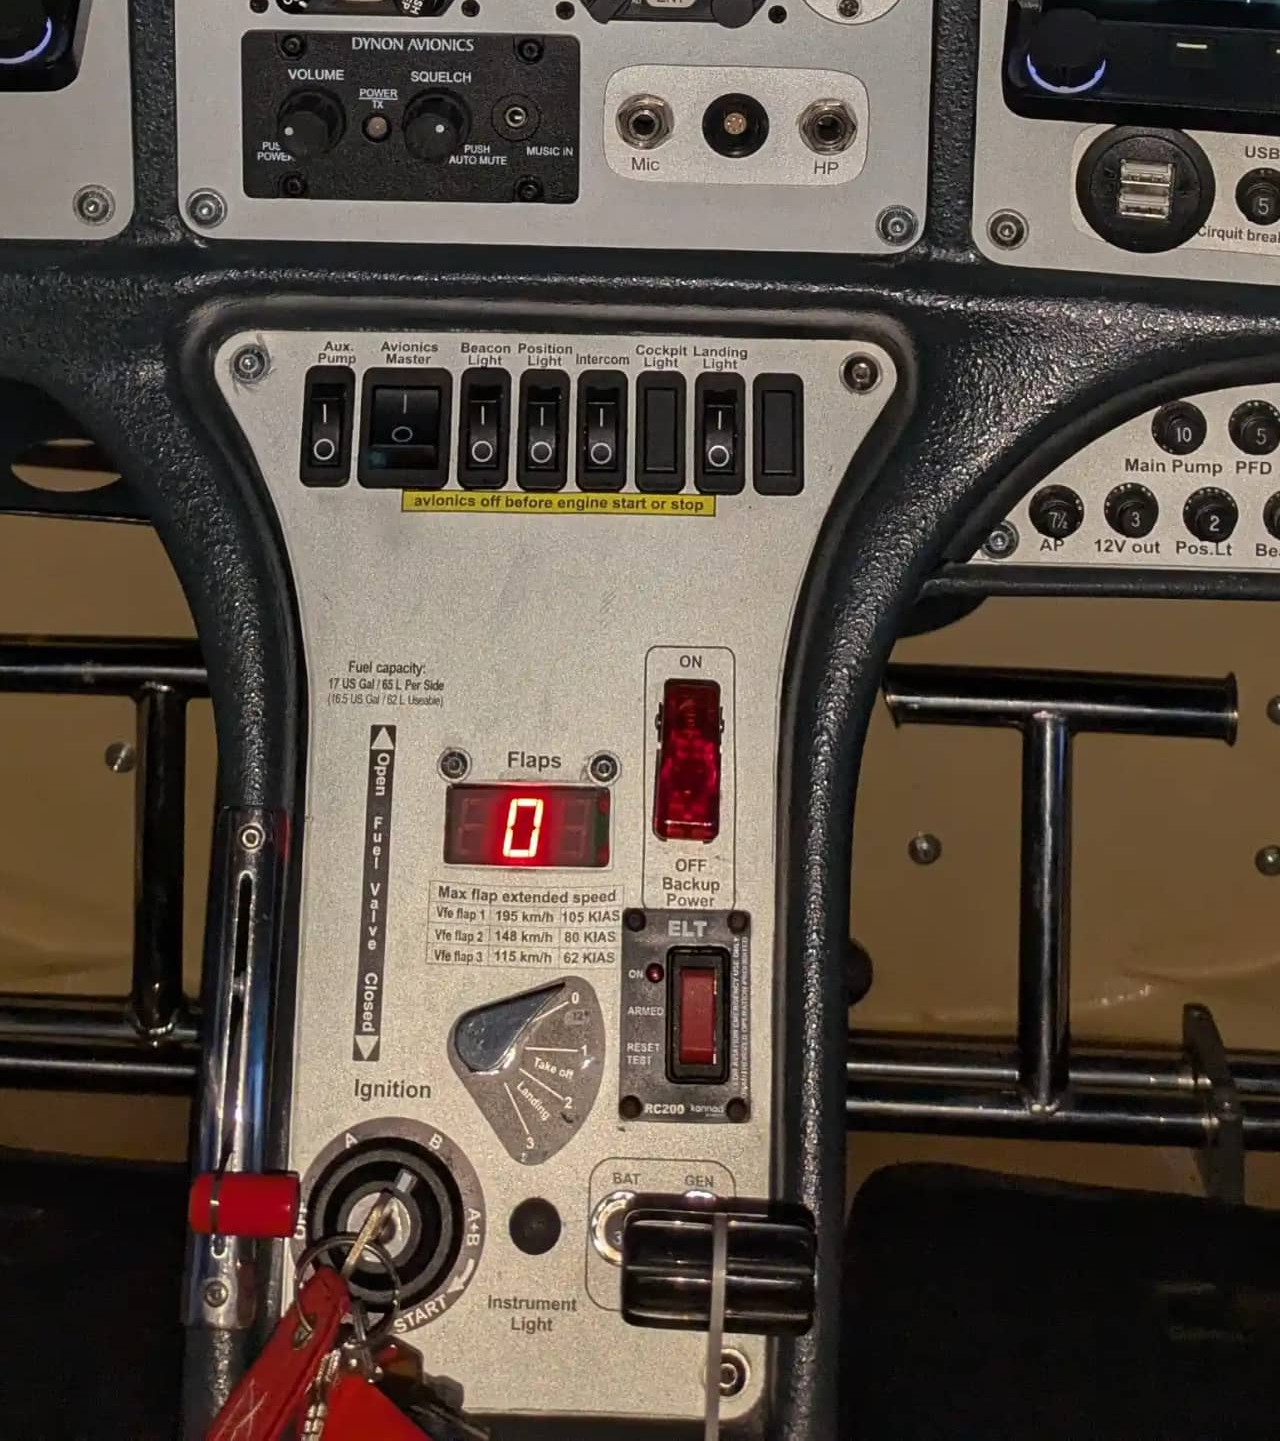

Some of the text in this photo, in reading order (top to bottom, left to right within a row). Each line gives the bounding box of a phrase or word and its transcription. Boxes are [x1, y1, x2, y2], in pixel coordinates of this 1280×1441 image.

[351, 37, 474, 52] DYNON AVIONICS
[288, 69, 344, 82] VOLUME
[411, 70, 471, 83] SQUELCH
[1244, 146, 1280, 160] USB
[631, 157, 660, 171] Mic
[814, 162, 838, 175] HP
[1198, 225, 1243, 241] Cirquit
[324, 341, 354, 352] Aux.
[381, 341, 438, 352] Avionics
[460, 343, 511, 354] Beacon
[518, 343, 572, 354] Position
[636, 344, 687, 358] Cockpit
[693, 345, 748, 360] Landing
[318, 353, 356, 365] Pump
[386, 353, 430, 365] Master
[468, 355, 502, 367] Light
[527, 355, 562, 367] Light
[576, 353, 630, 365] Intercom
[644, 357, 678, 370] Light
[703, 358, 738, 371] Light
[1125, 458, 1223, 476] Main Pump
[1235, 461, 1273, 476] PFD
[414, 496, 704, 512] avionics off before engine start or stop
[1097, 539, 1161, 555] 12V out
[1175, 540, 1233, 557] Pos.Lt
[507, 751, 561, 772] Flaps
[503, 798, 544, 857] 0
[675, 859, 707, 872] OFF
[663, 877, 720, 894] Backup
[438, 886, 616, 905] Max flap extended speed
[667, 894, 715, 907] Power
[668, 920, 708, 938] ELT
[354, 1079, 431, 1100] Ignition
[487, 1294, 577, 1313] Instrument
[510, 1315, 553, 1334] Light
